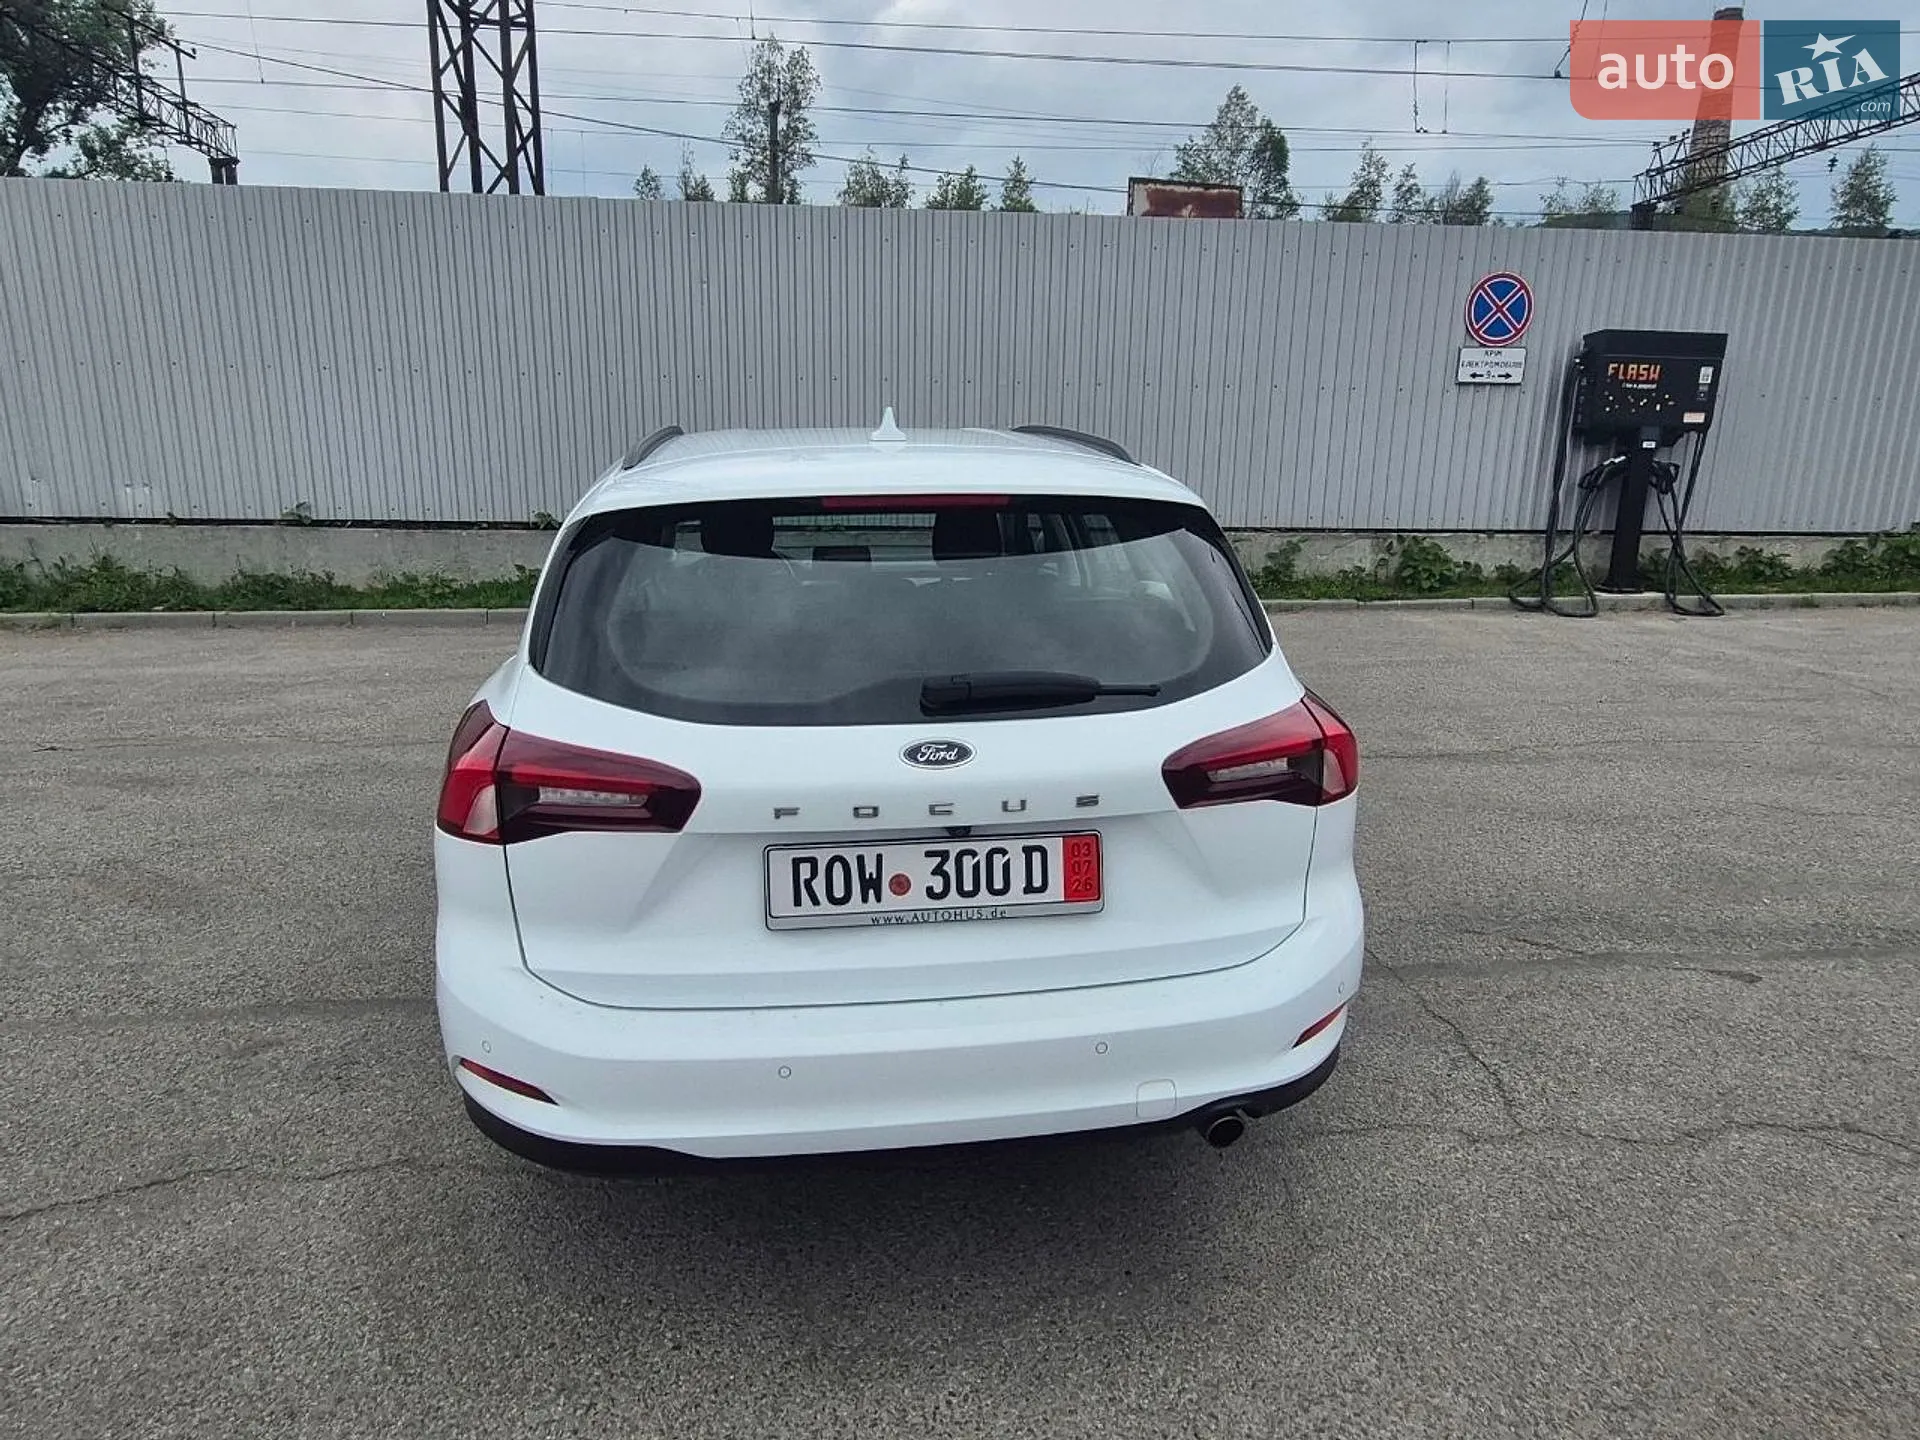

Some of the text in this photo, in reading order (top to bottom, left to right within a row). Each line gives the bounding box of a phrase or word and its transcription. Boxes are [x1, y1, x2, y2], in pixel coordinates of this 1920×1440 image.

[1607, 363, 1661, 380] FLASH
[917, 743, 958, 761] Ford
[773, 794, 1099, 820] FOCUS
[1071, 842, 1091, 857] 03
[791, 844, 1049, 907] ROW 300 D
[1071, 860, 1091, 875] 07
[1071, 877, 1093, 893] 26
[871, 908, 1007, 925] www.AUTOHUS.de
